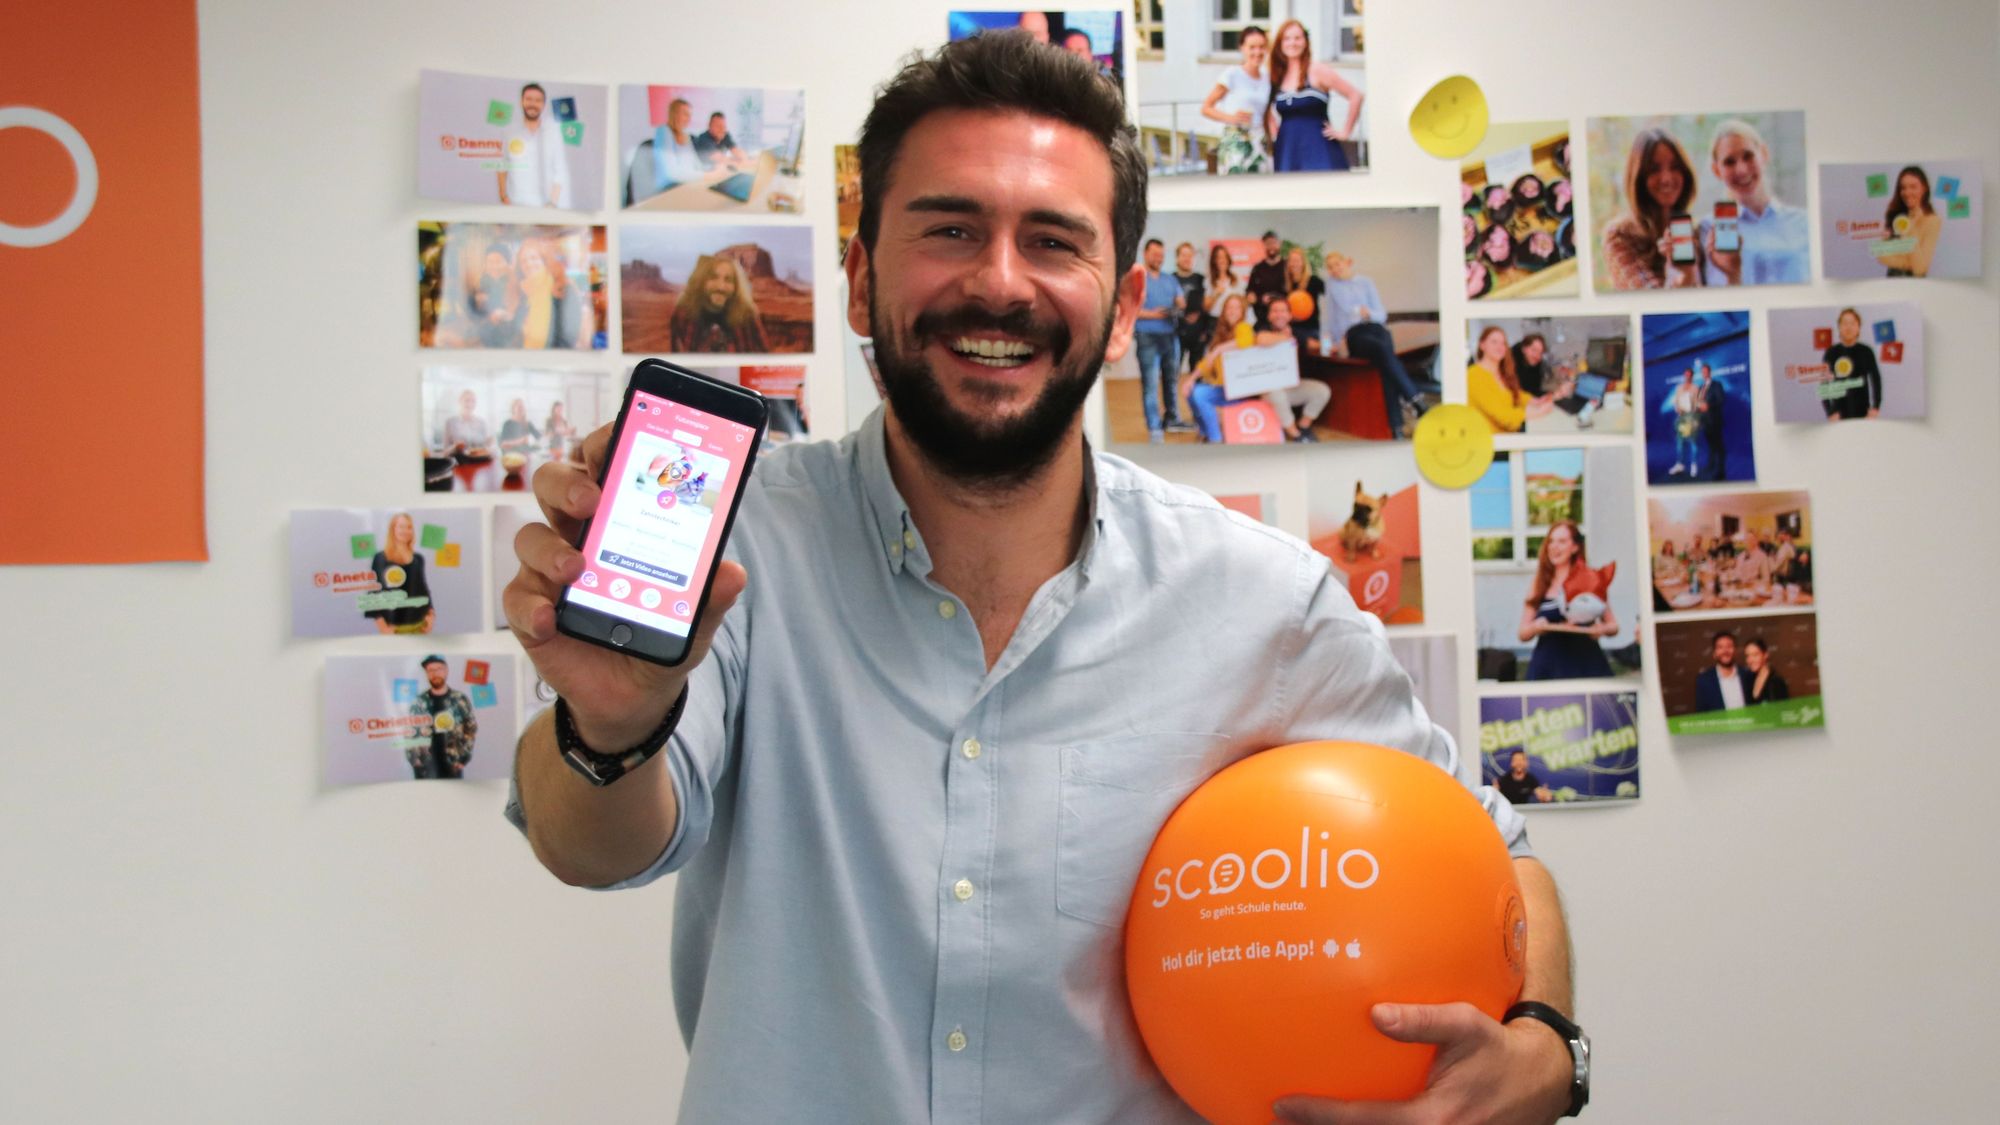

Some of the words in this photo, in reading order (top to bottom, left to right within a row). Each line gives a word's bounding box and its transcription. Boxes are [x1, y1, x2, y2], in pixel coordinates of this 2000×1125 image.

[1152, 825, 1380, 909] scoolio
[1200, 908, 1212, 920] So
[1213, 905, 1235, 921] geht
[1237, 902, 1271, 914] Schule
[1272, 900, 1307, 911] heute.
[1162, 953, 1182, 972] Hol
[1185, 949, 1203, 967] dir
[1207, 946, 1242, 968] jetzt
[1246, 942, 1271, 959] die
[1275, 939, 1314, 960] App!
